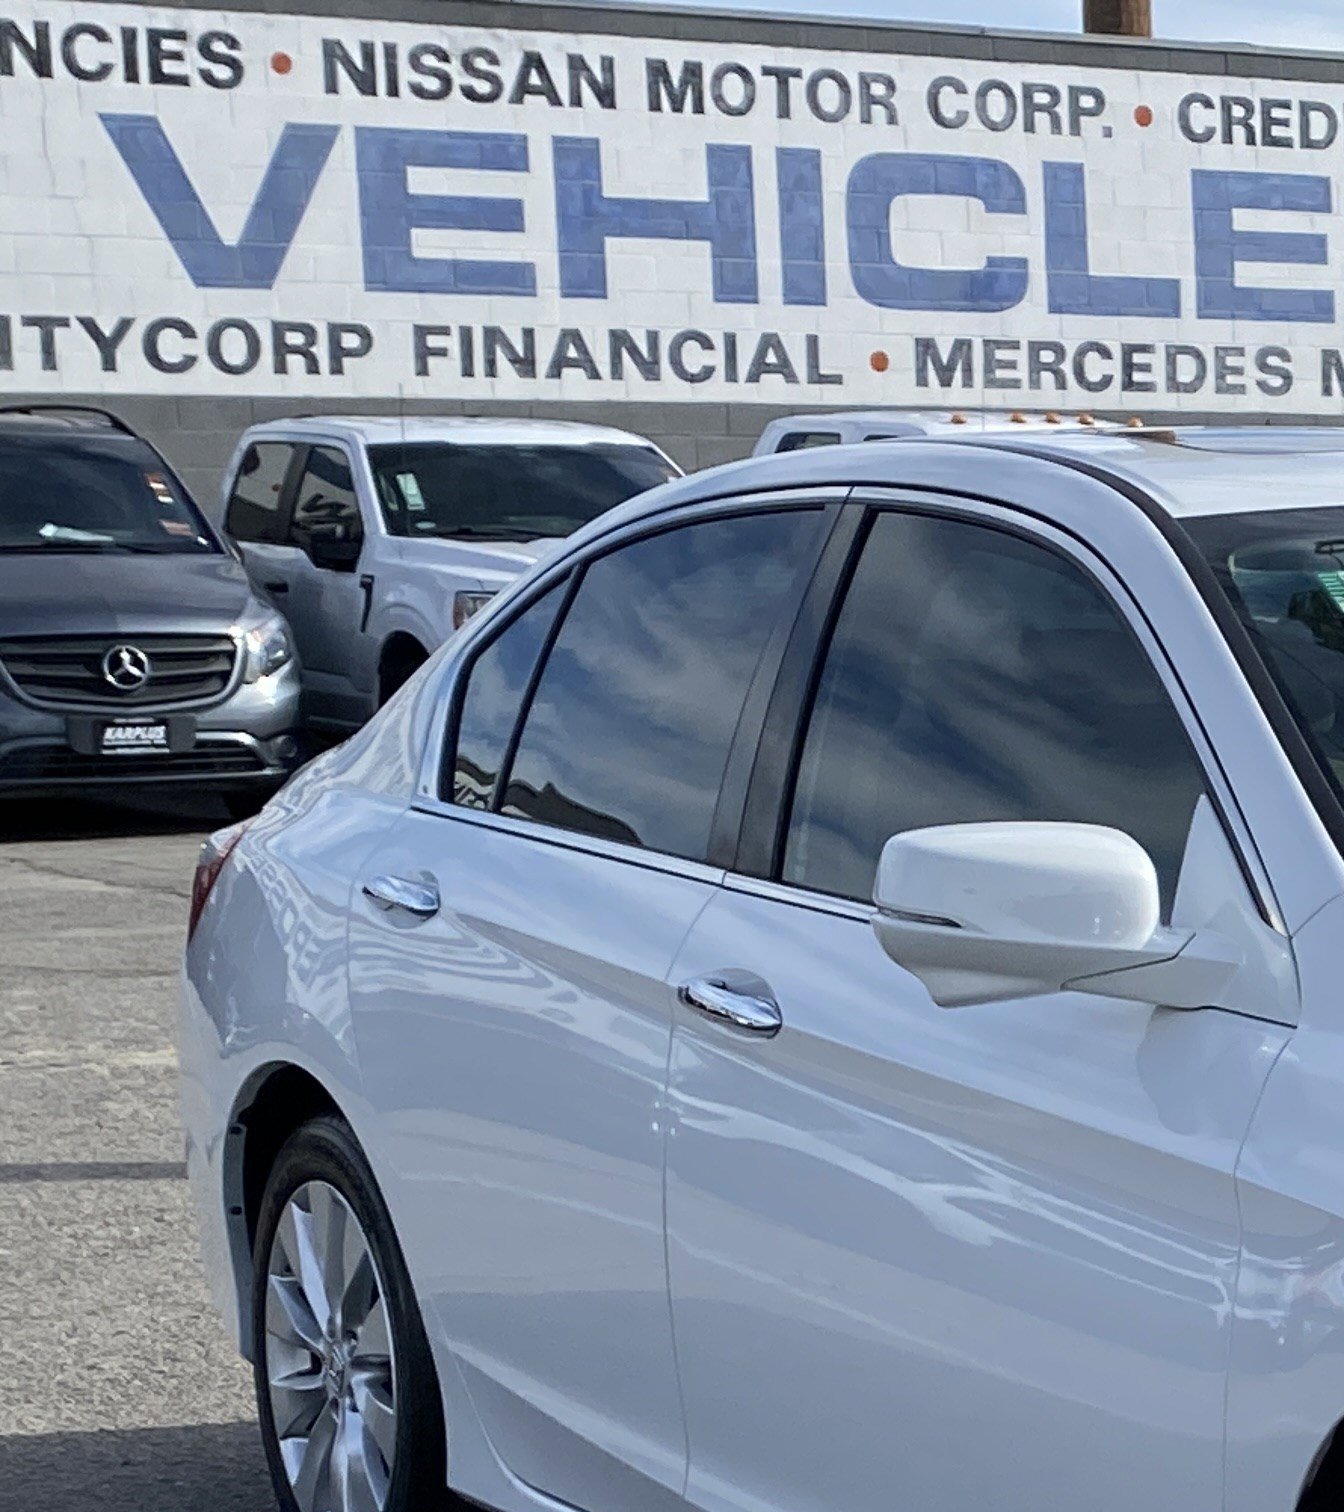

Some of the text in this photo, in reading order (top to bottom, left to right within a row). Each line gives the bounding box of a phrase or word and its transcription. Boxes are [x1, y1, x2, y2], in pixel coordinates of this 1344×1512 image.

[322, 39, 616, 109] NISSAN
[647, 57, 897, 126] MOTOR
[926, 75, 1113, 138] CORP.
[414, 324, 843, 385] FINANCIAL
[914, 337, 1293, 395] MERCEDES
